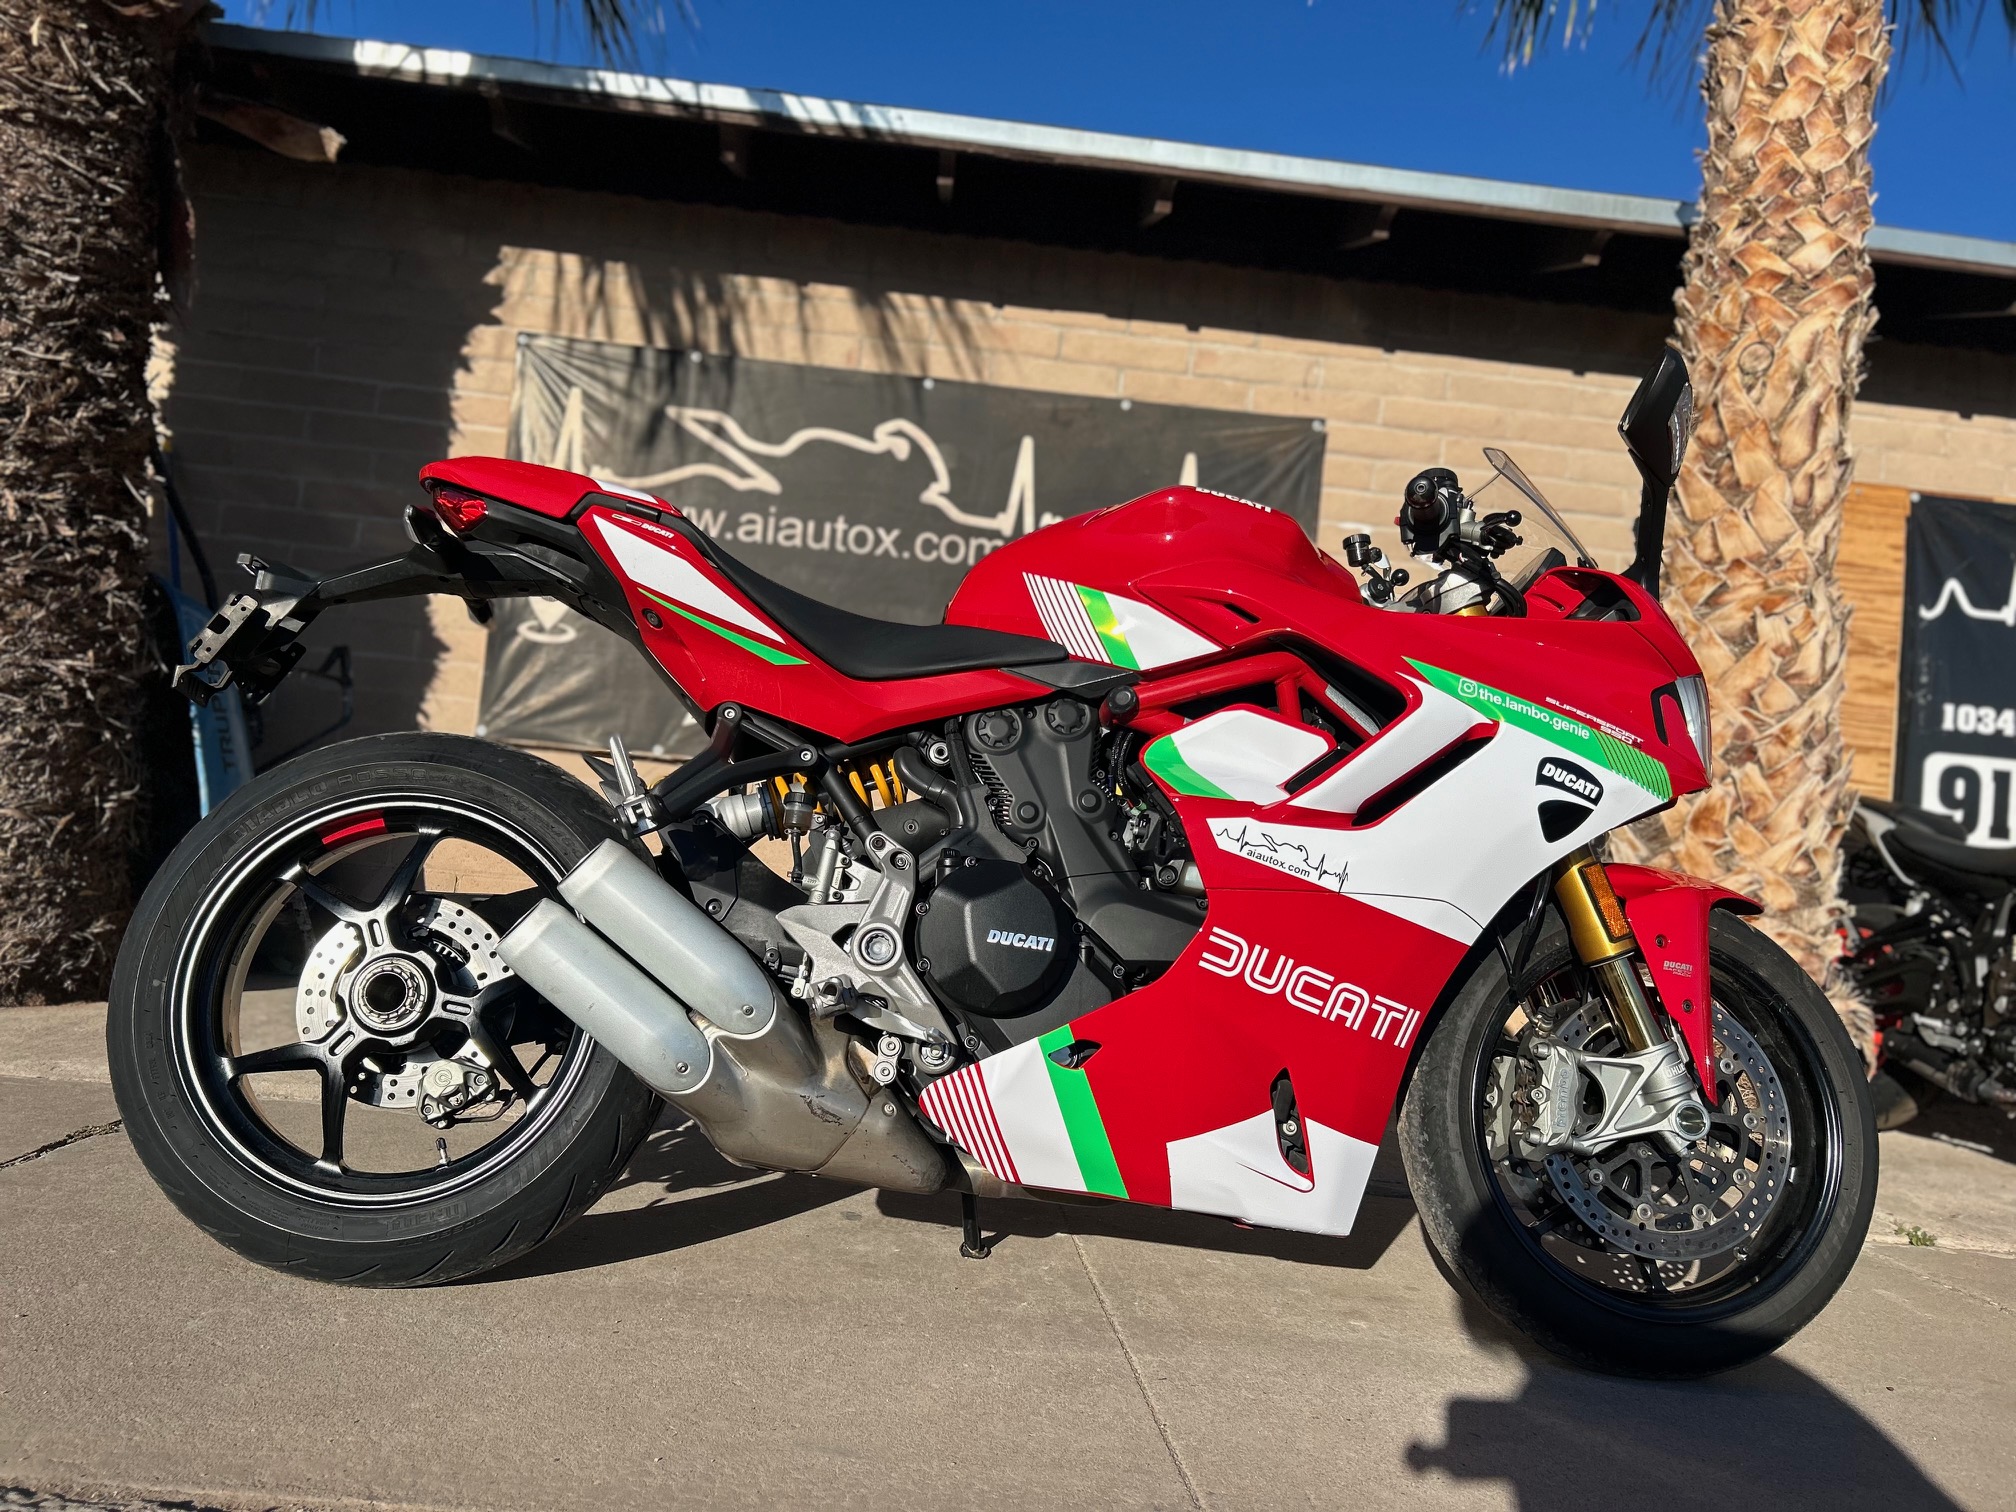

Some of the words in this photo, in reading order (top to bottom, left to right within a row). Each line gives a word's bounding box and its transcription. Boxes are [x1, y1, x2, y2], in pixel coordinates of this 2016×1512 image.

[1195, 486, 1272, 513] DUCATI
[641, 523, 675, 539] DUCATI
[1478, 686, 1590, 740] the.lambo.genie
[1941, 701, 2015, 738] 1034
[1541, 762, 1600, 799] DUCATI
[1938, 764, 2012, 843] 91
[1246, 848, 1311, 878] aiautox.com
[986, 929, 1055, 952] DUCATI
[1663, 960, 1693, 972] DUCATI
[1198, 926, 1421, 1049] DUCATI
[1553, 1069, 1570, 1128] brembo
